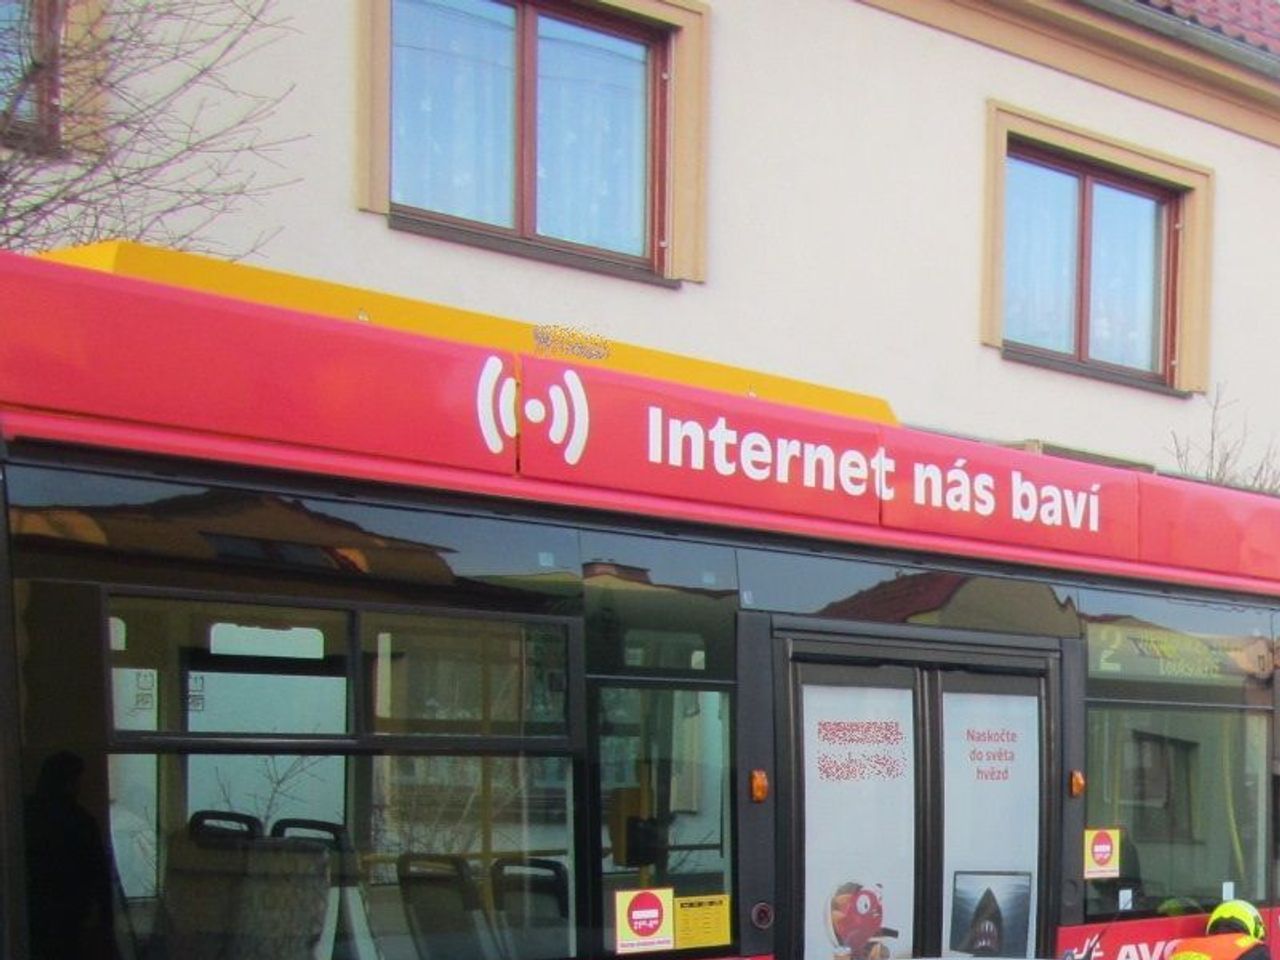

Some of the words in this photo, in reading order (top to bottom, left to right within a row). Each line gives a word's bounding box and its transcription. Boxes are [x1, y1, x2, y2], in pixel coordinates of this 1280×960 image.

[648, 406, 895, 501] Internet
[913, 459, 996, 517] nás
[1011, 471, 1100, 532] baví
[966, 729, 1018, 743] Naskočte
[969, 750, 984, 761] do
[986, 751, 1014, 761] světa
[976, 767, 1009, 781] hvězd
